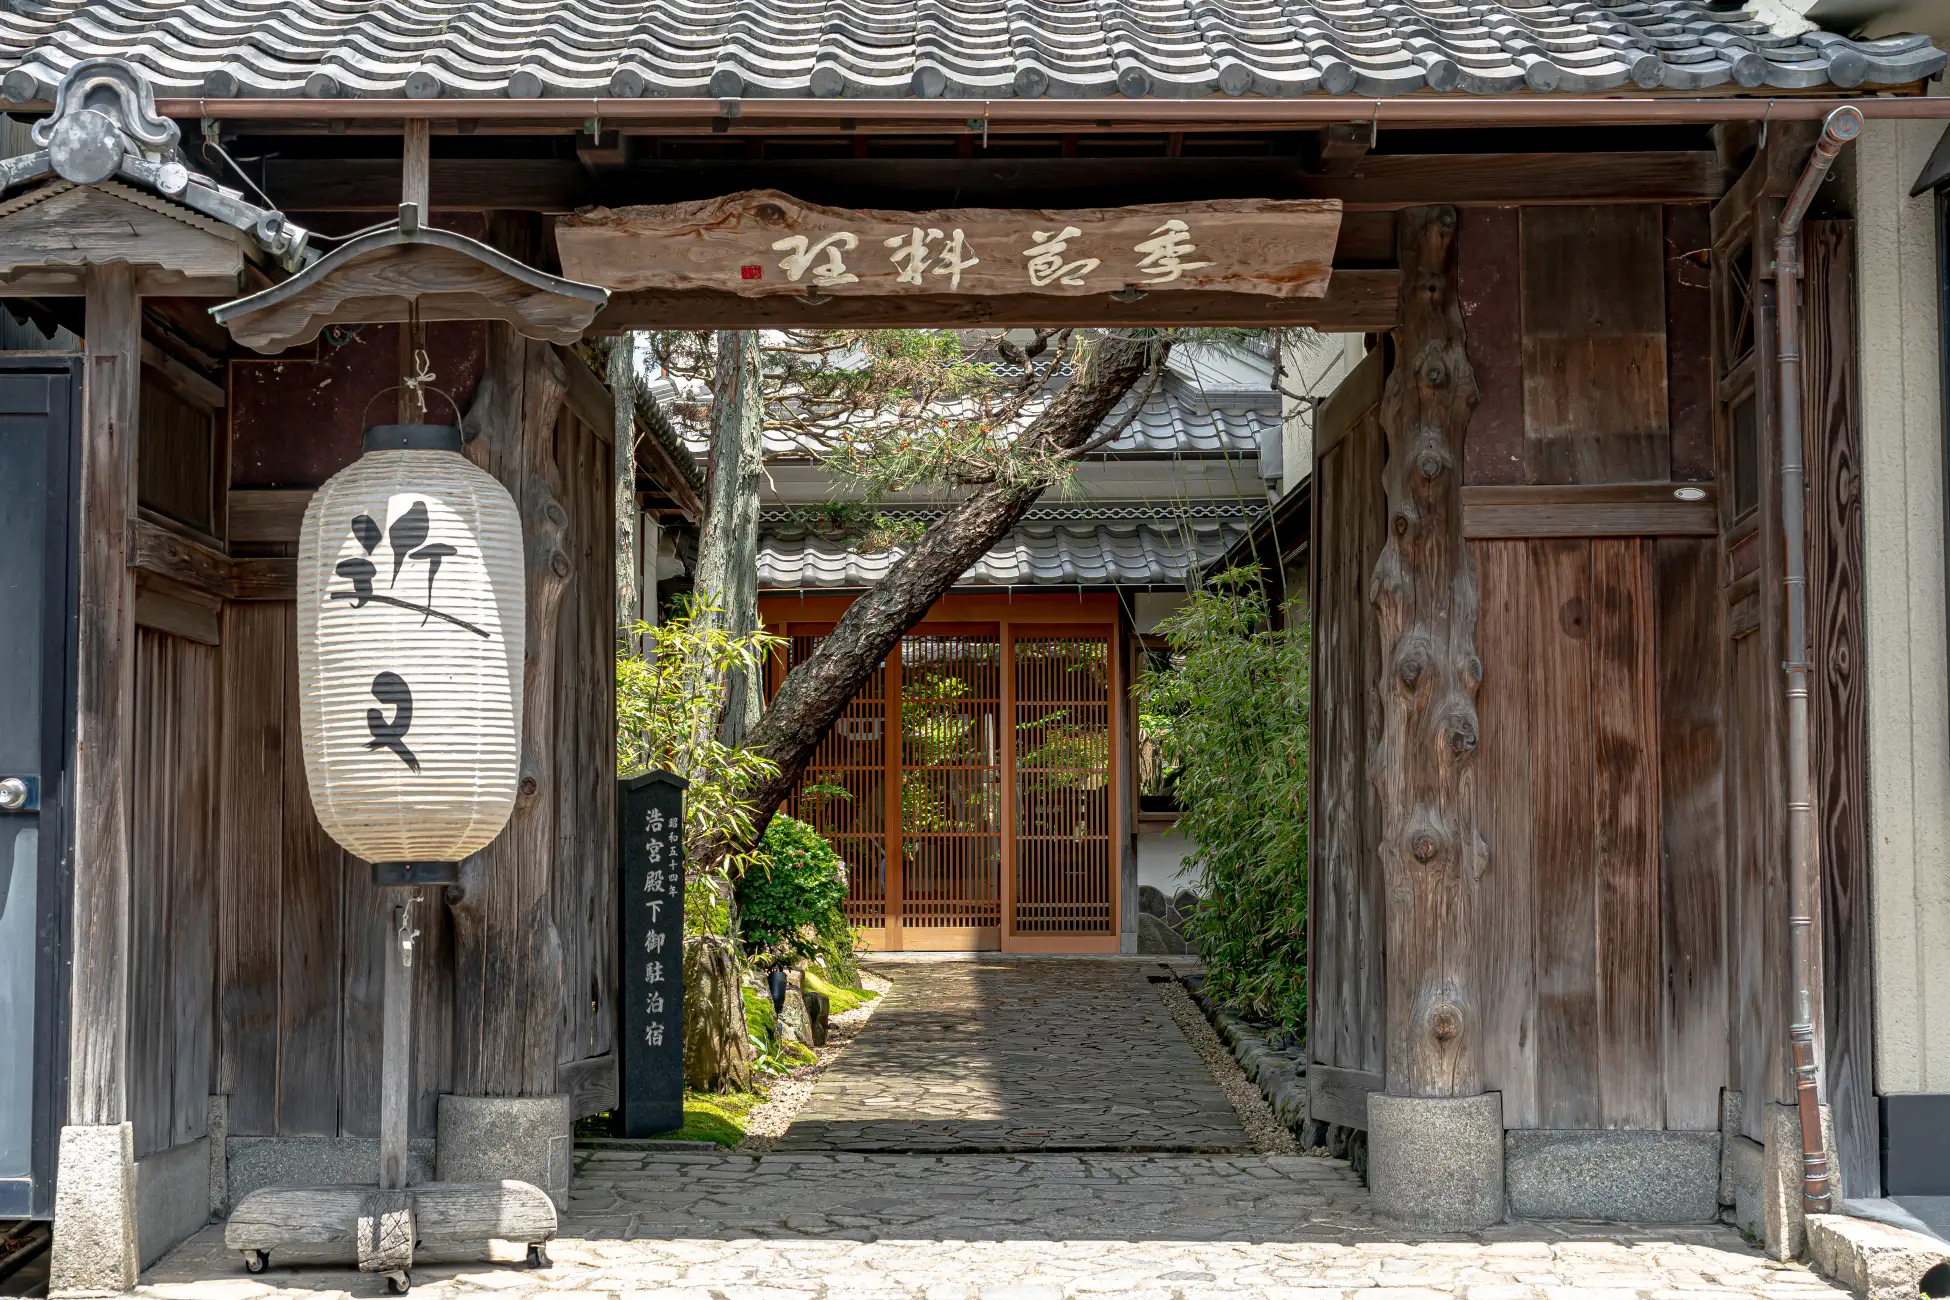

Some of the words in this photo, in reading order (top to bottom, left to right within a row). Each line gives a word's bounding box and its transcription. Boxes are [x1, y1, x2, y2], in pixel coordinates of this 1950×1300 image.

[644, 807, 666, 1047] 浩宮殿下御駐泊宿
[668, 817, 679, 898] 昭和五十四年
